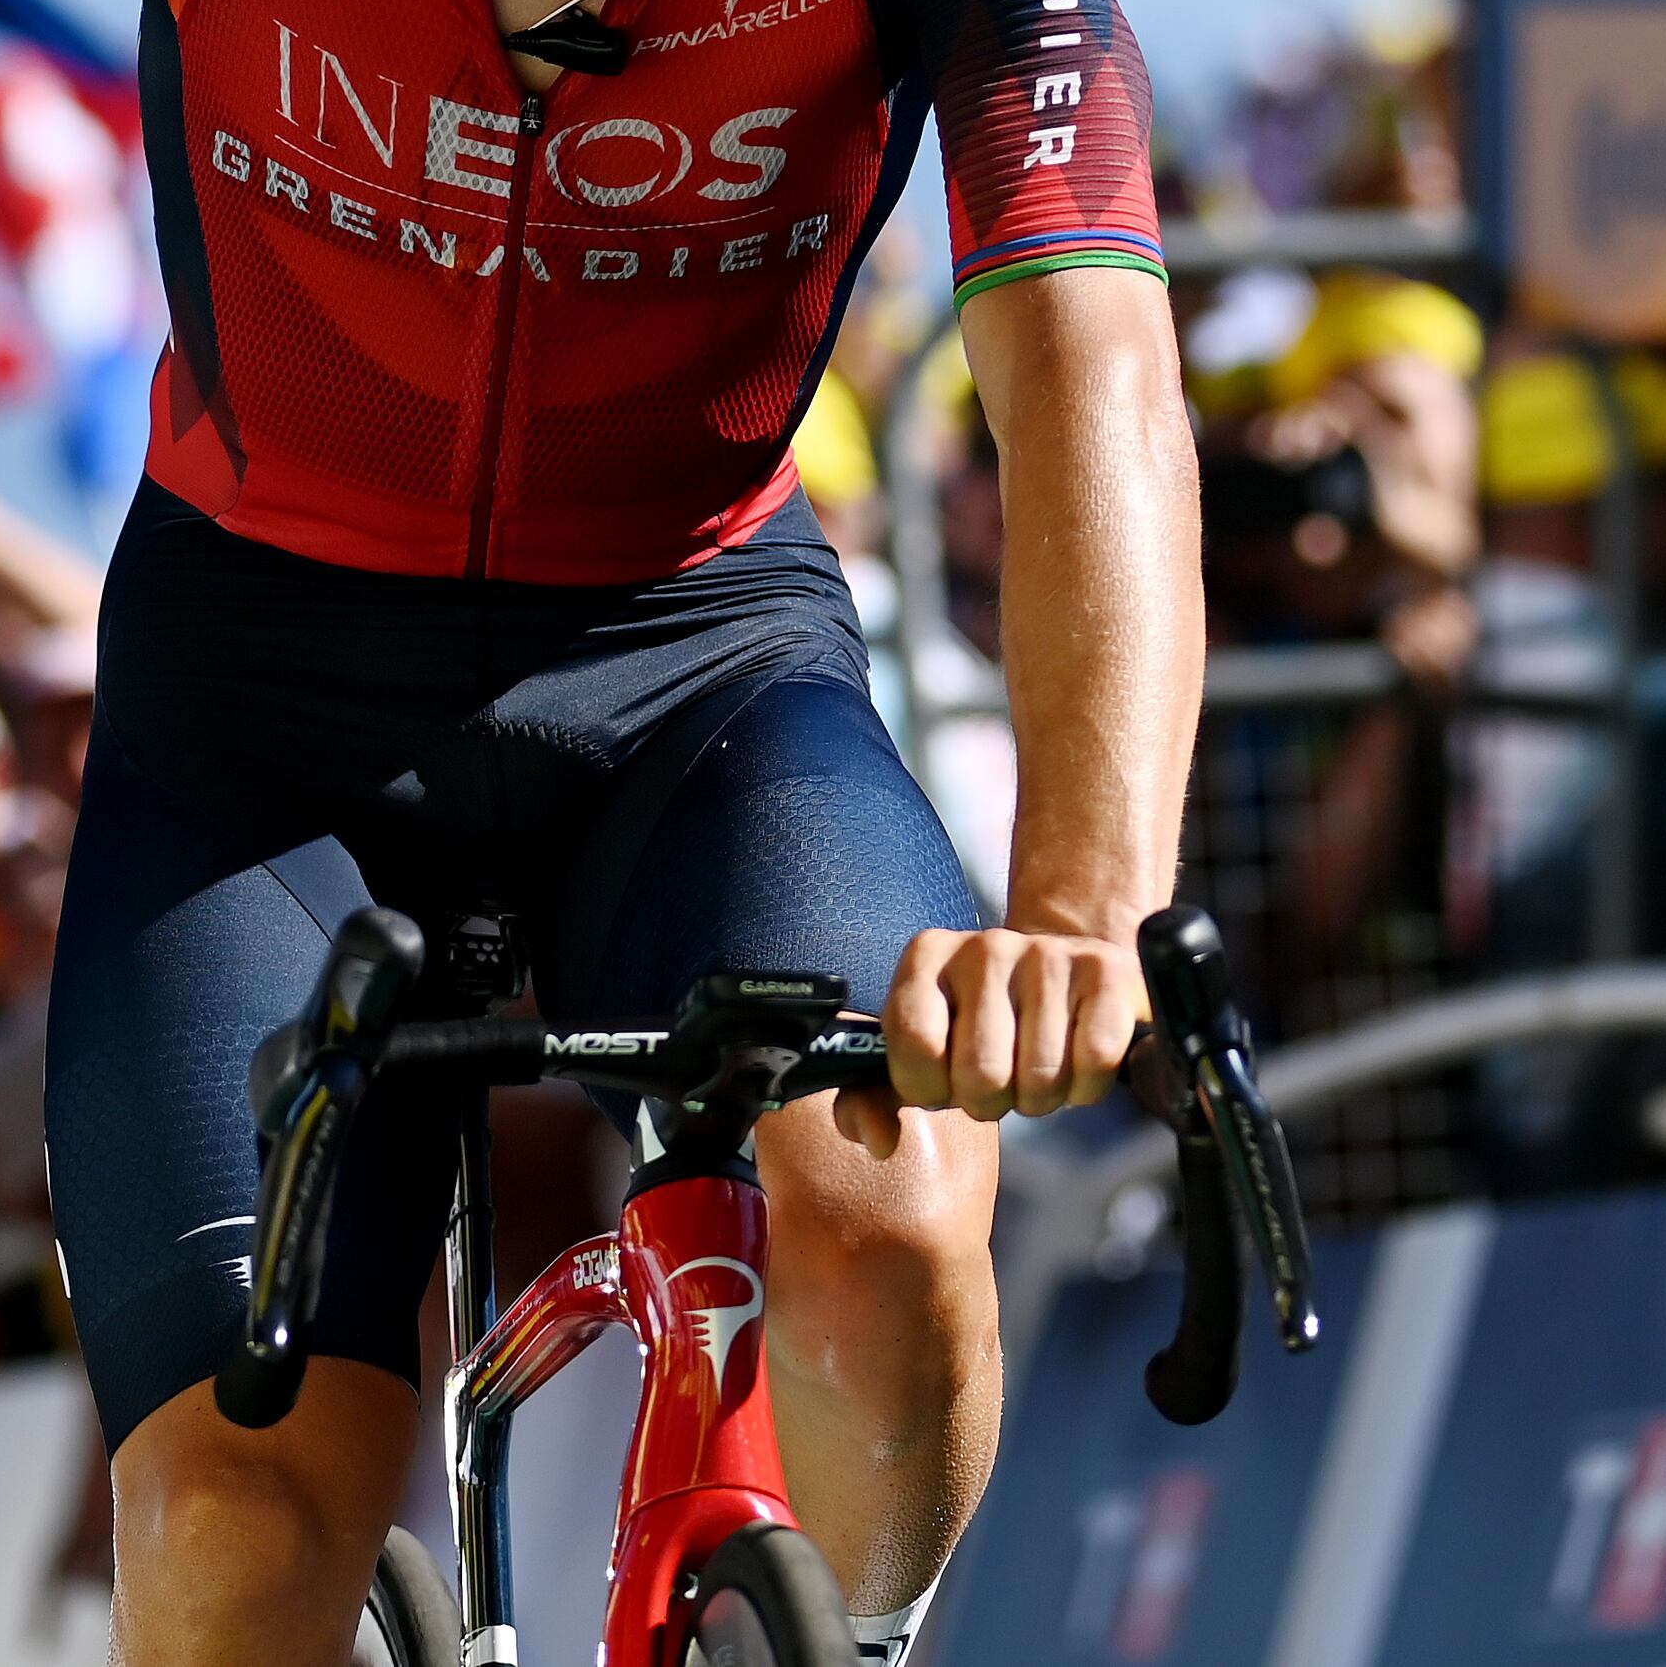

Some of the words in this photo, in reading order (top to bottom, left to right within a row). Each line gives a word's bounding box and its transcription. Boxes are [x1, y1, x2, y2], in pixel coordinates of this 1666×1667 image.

[272, 19, 798, 208] INEOS
[211, 129, 829, 284] GRENADIER
[738, 979, 815, 996] GARMIN
